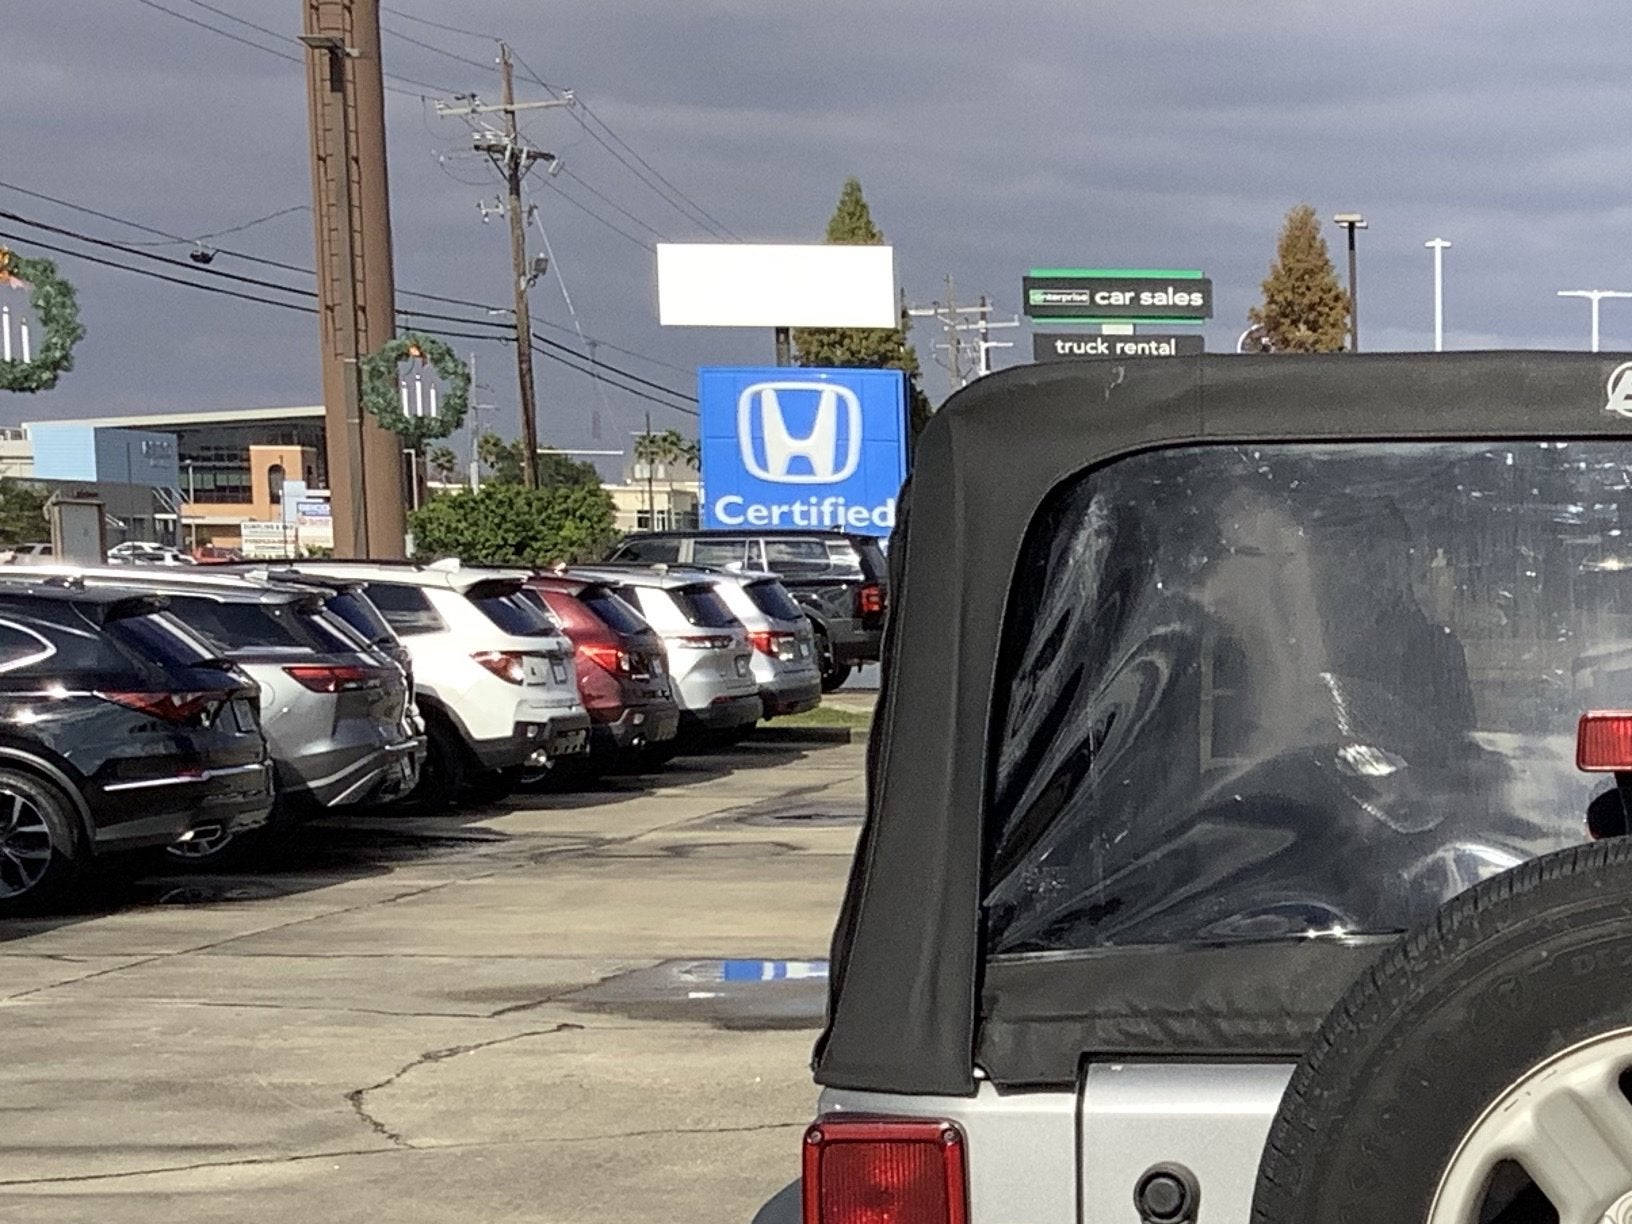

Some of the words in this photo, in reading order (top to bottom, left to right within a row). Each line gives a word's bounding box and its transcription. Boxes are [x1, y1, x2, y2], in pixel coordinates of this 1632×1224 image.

[1095, 291, 1135, 305] car
[1140, 286, 1204, 306] sales
[1055, 337, 1109, 355] truck
[1116, 338, 1176, 355] rental
[714, 494, 896, 528] Certified
